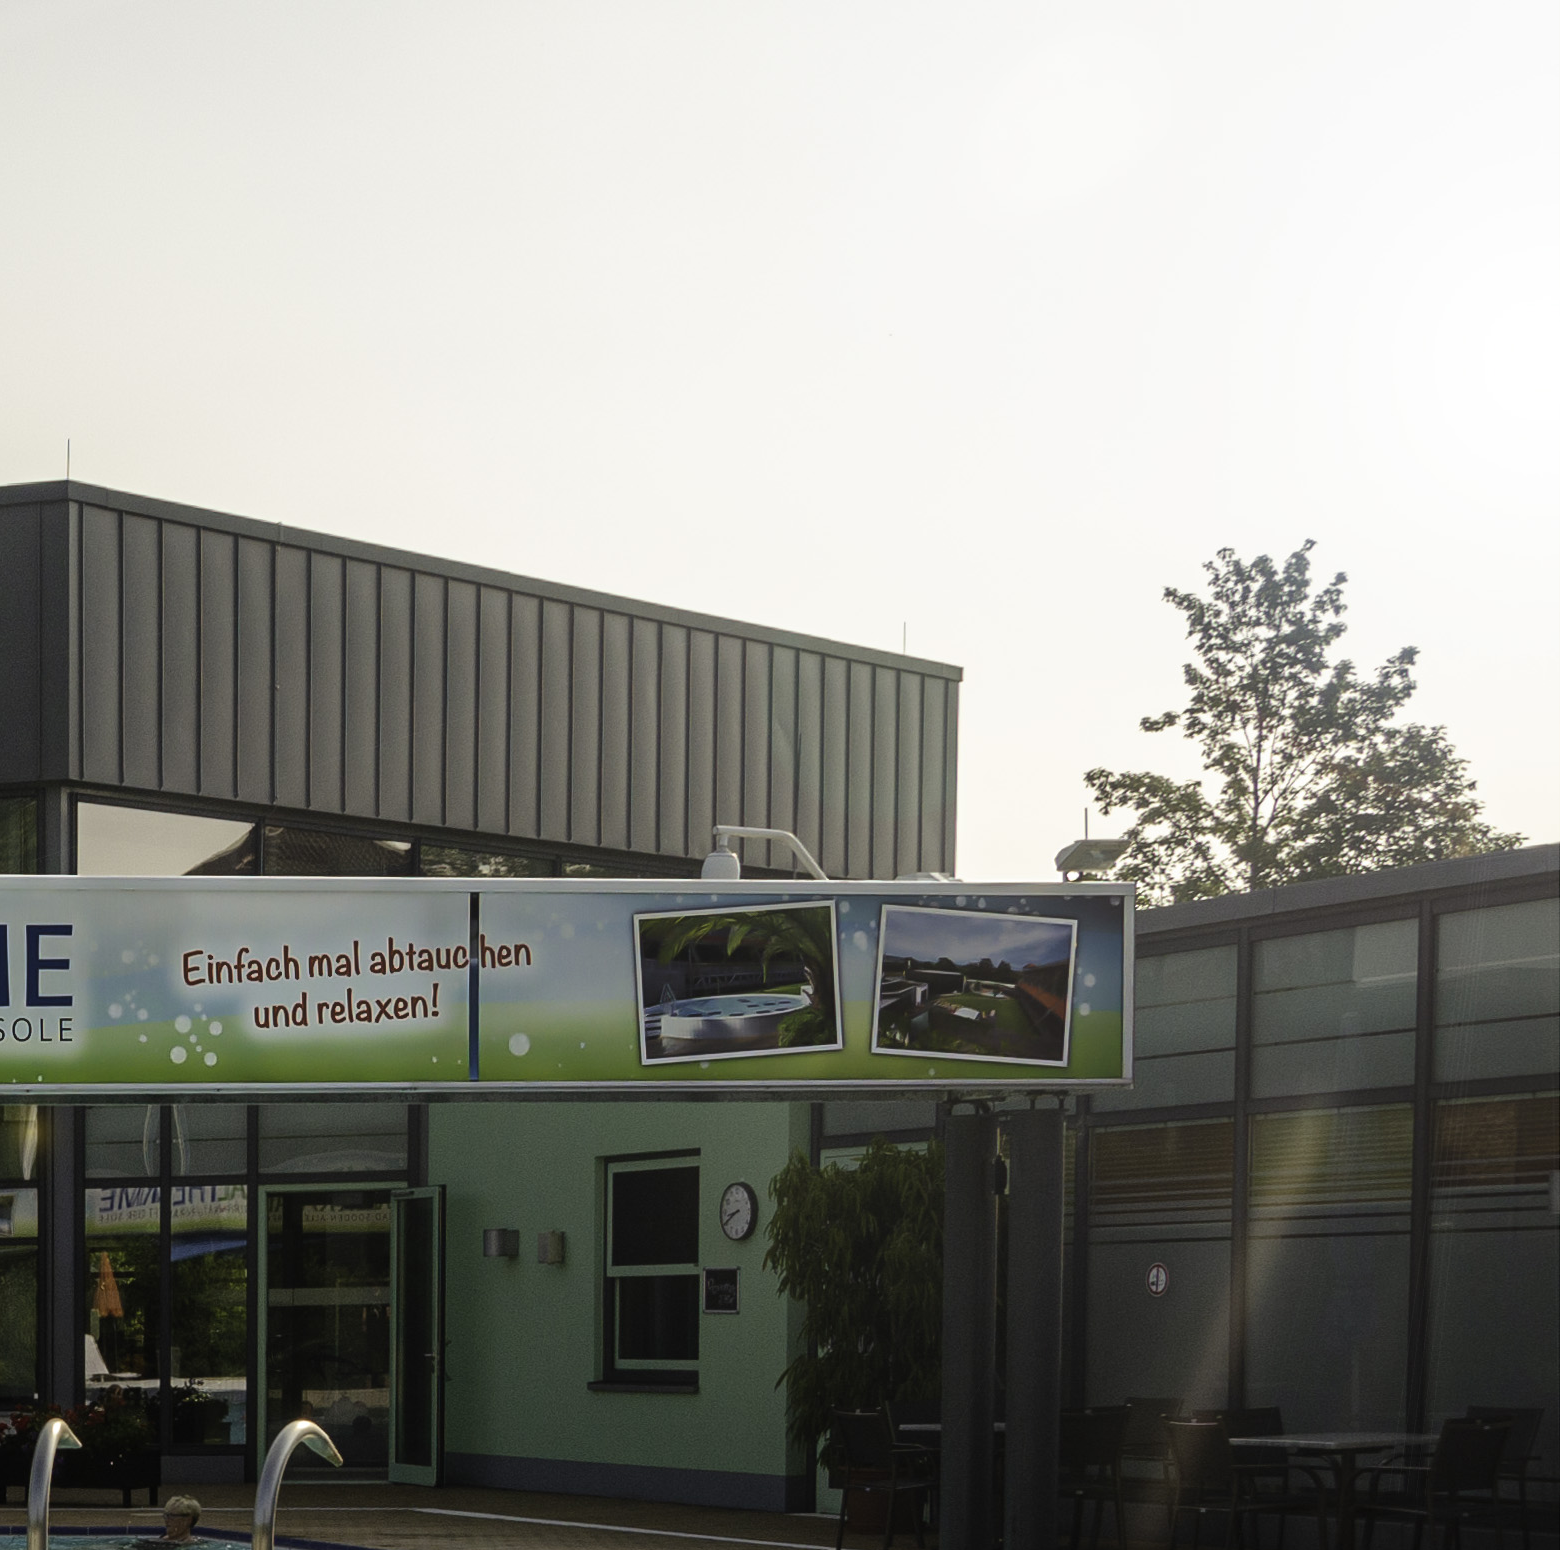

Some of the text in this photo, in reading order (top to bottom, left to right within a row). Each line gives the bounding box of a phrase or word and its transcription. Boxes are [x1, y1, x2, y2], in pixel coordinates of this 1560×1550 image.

[182, 934, 532, 987] Einfach mal abtauchen
[254, 982, 440, 1029] und relaxen!
